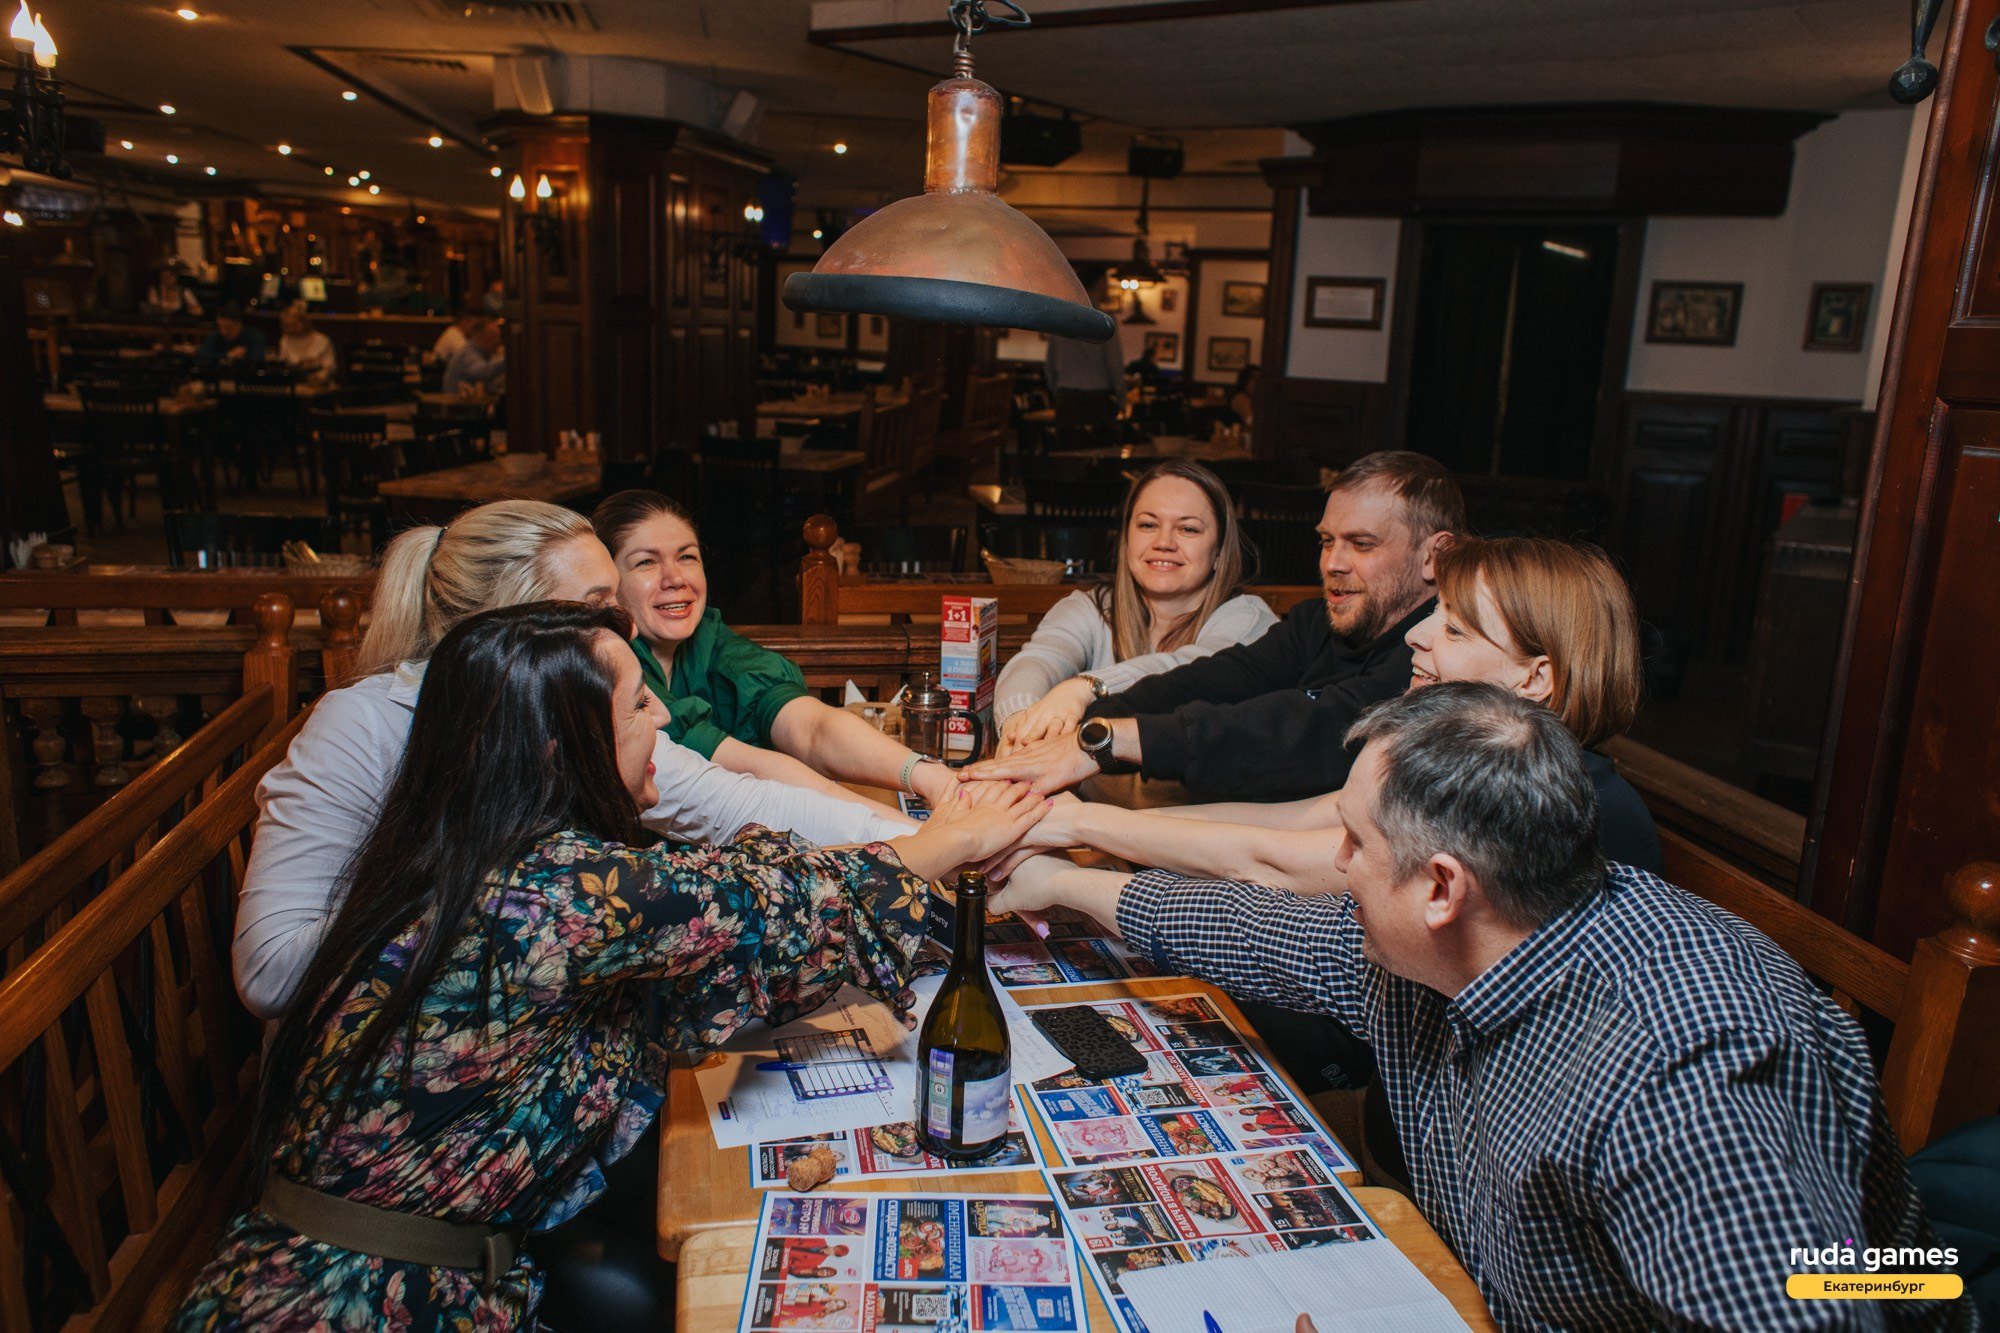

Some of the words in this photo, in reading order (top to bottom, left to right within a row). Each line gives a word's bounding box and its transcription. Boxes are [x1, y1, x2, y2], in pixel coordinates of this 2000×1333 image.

[948, 721, 966, 731] 0%
[930, 910, 949, 928] Party
[1166, 1055, 1206, 1104] MAXIMILIANS.RU
[1140, 1116, 1175, 1157] ИННИКАМ
[1193, 1113, 1226, 1151] А=ВОЗРАСТУ
[1143, 1164, 1173, 1201] ПОДАРОК
[948, 1201, 961, 1279] ИМЕНИННИКАМ
